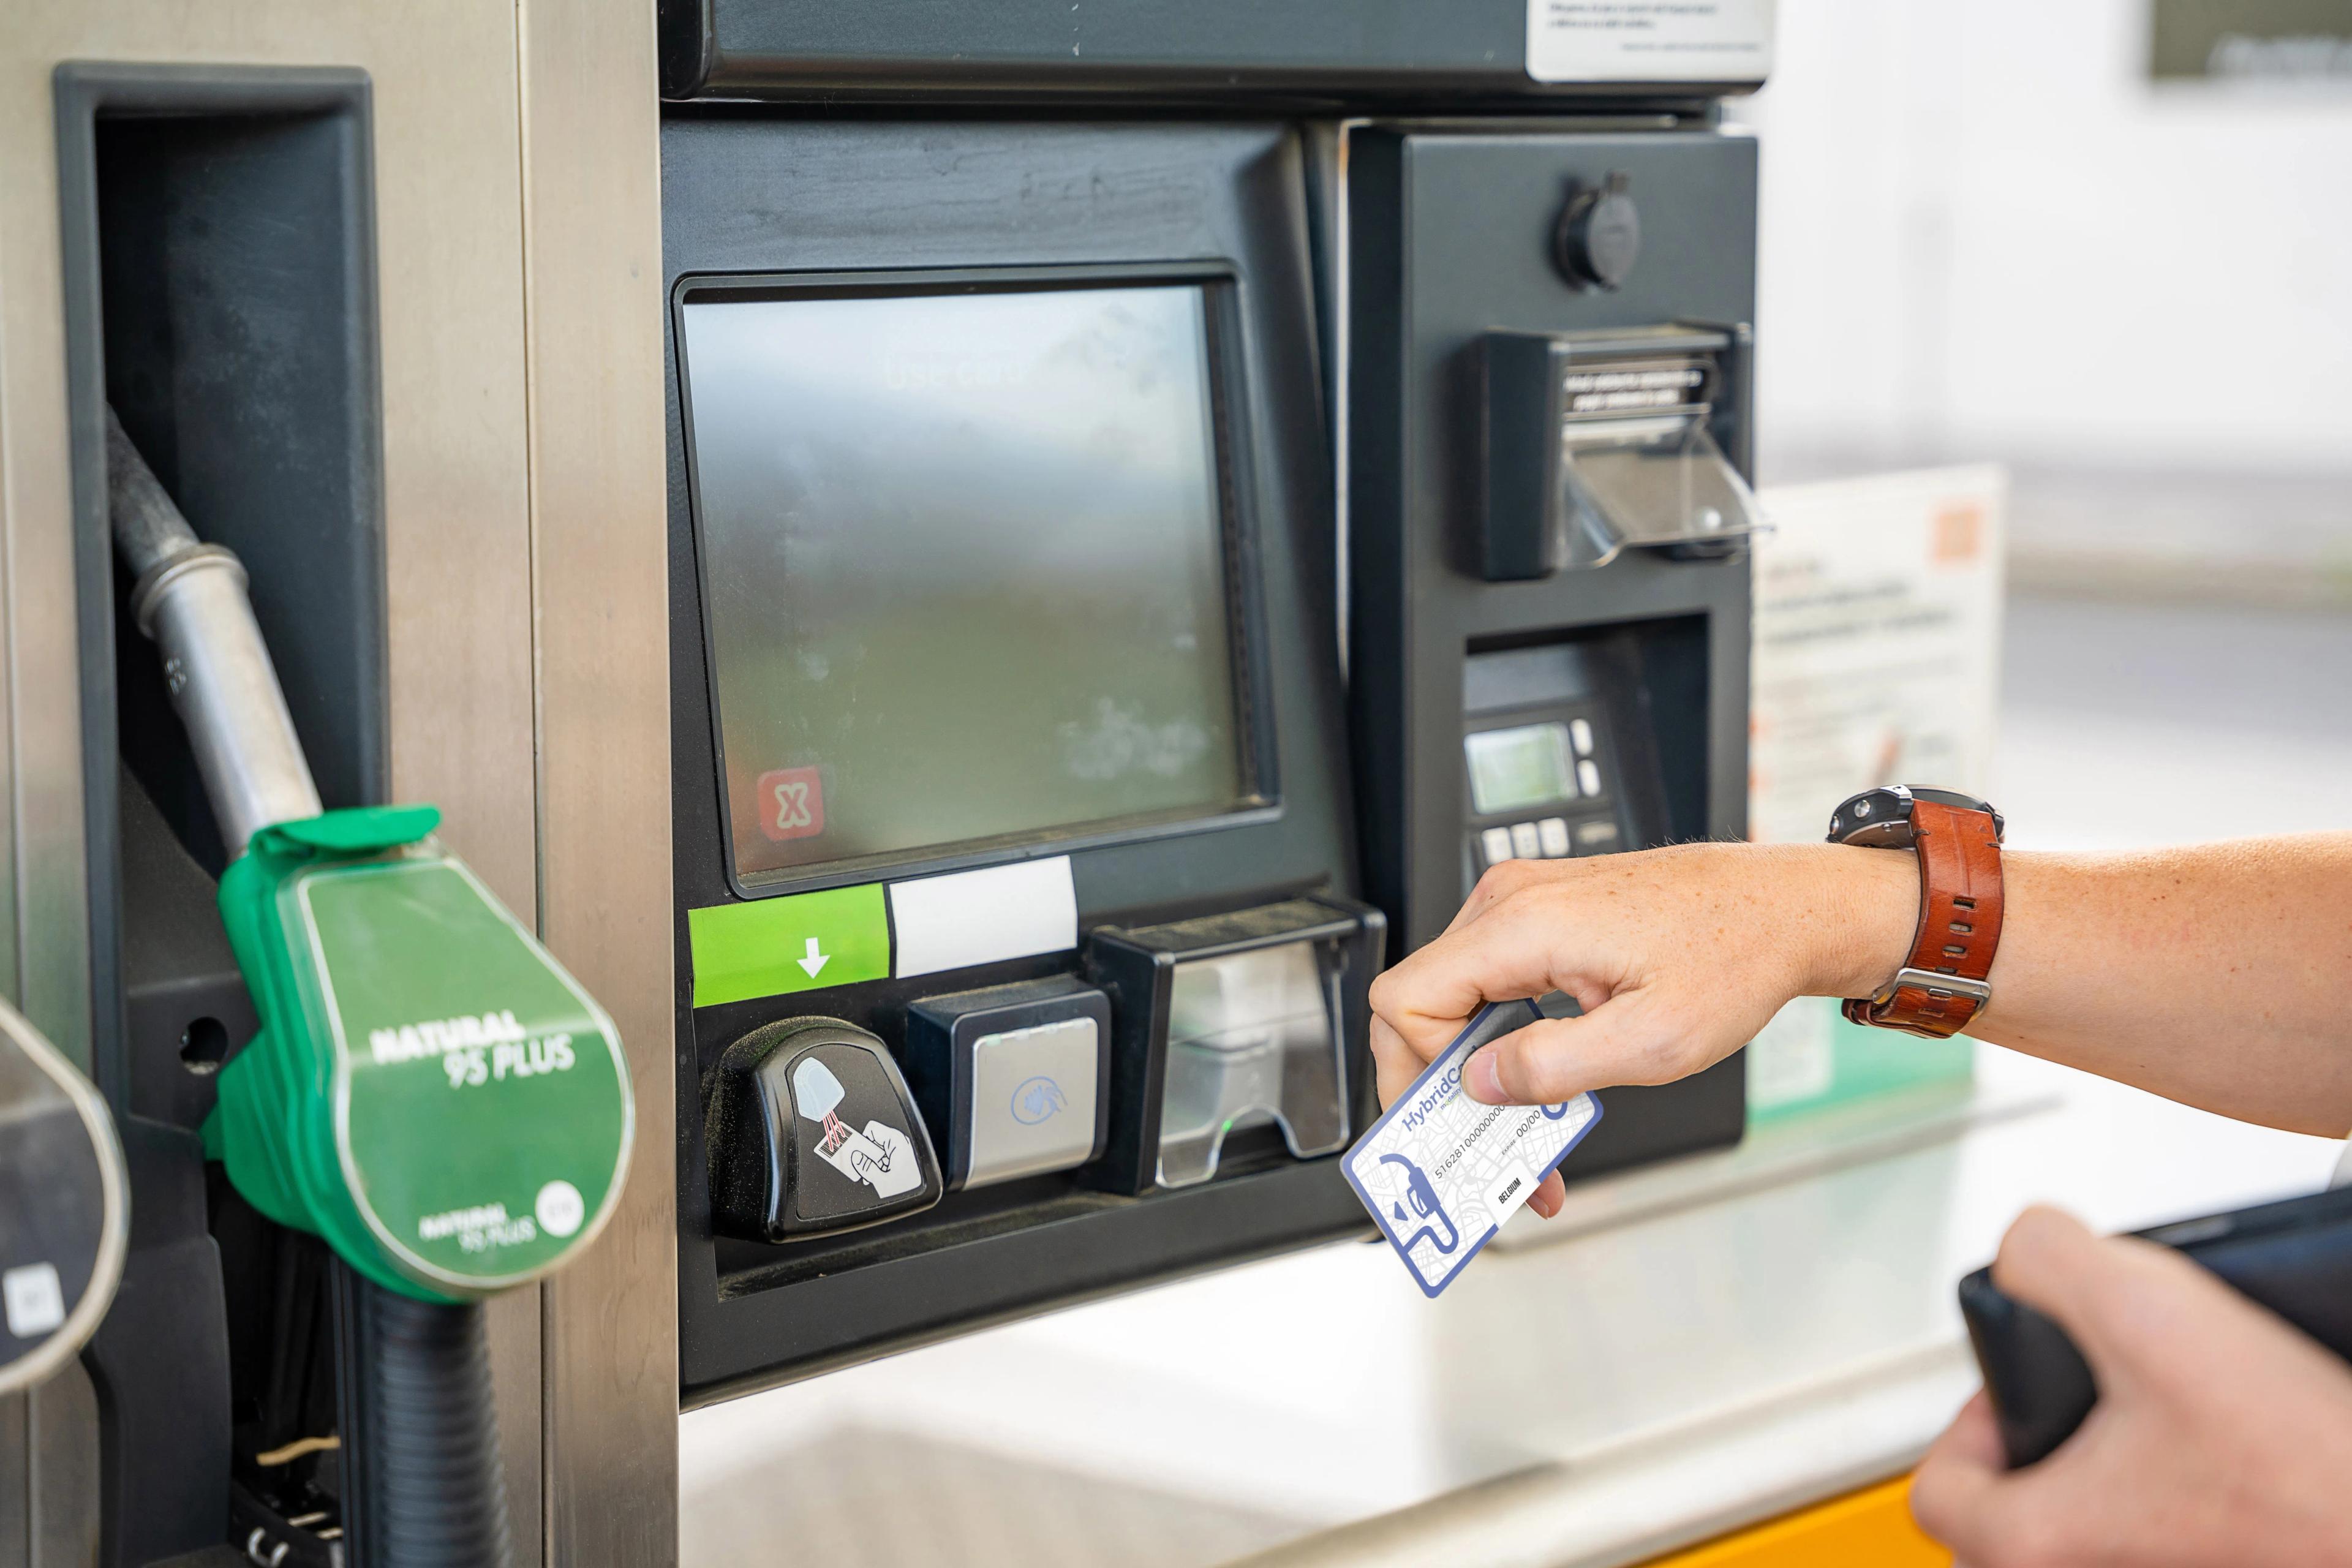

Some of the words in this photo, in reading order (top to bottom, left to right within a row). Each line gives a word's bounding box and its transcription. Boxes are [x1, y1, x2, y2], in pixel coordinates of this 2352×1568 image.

[369, 1009, 526, 1065] NATURAL
[443, 1047, 489, 1089] 95
[492, 1033, 576, 1081] PLUS
[1402, 1045, 1477, 1132] HybridC
[1502, 1139, 1516, 1155] EXPIRE
[1516, 1110, 1540, 1137] 00/00
[1498, 1177, 1521, 1204] BELGIUM
